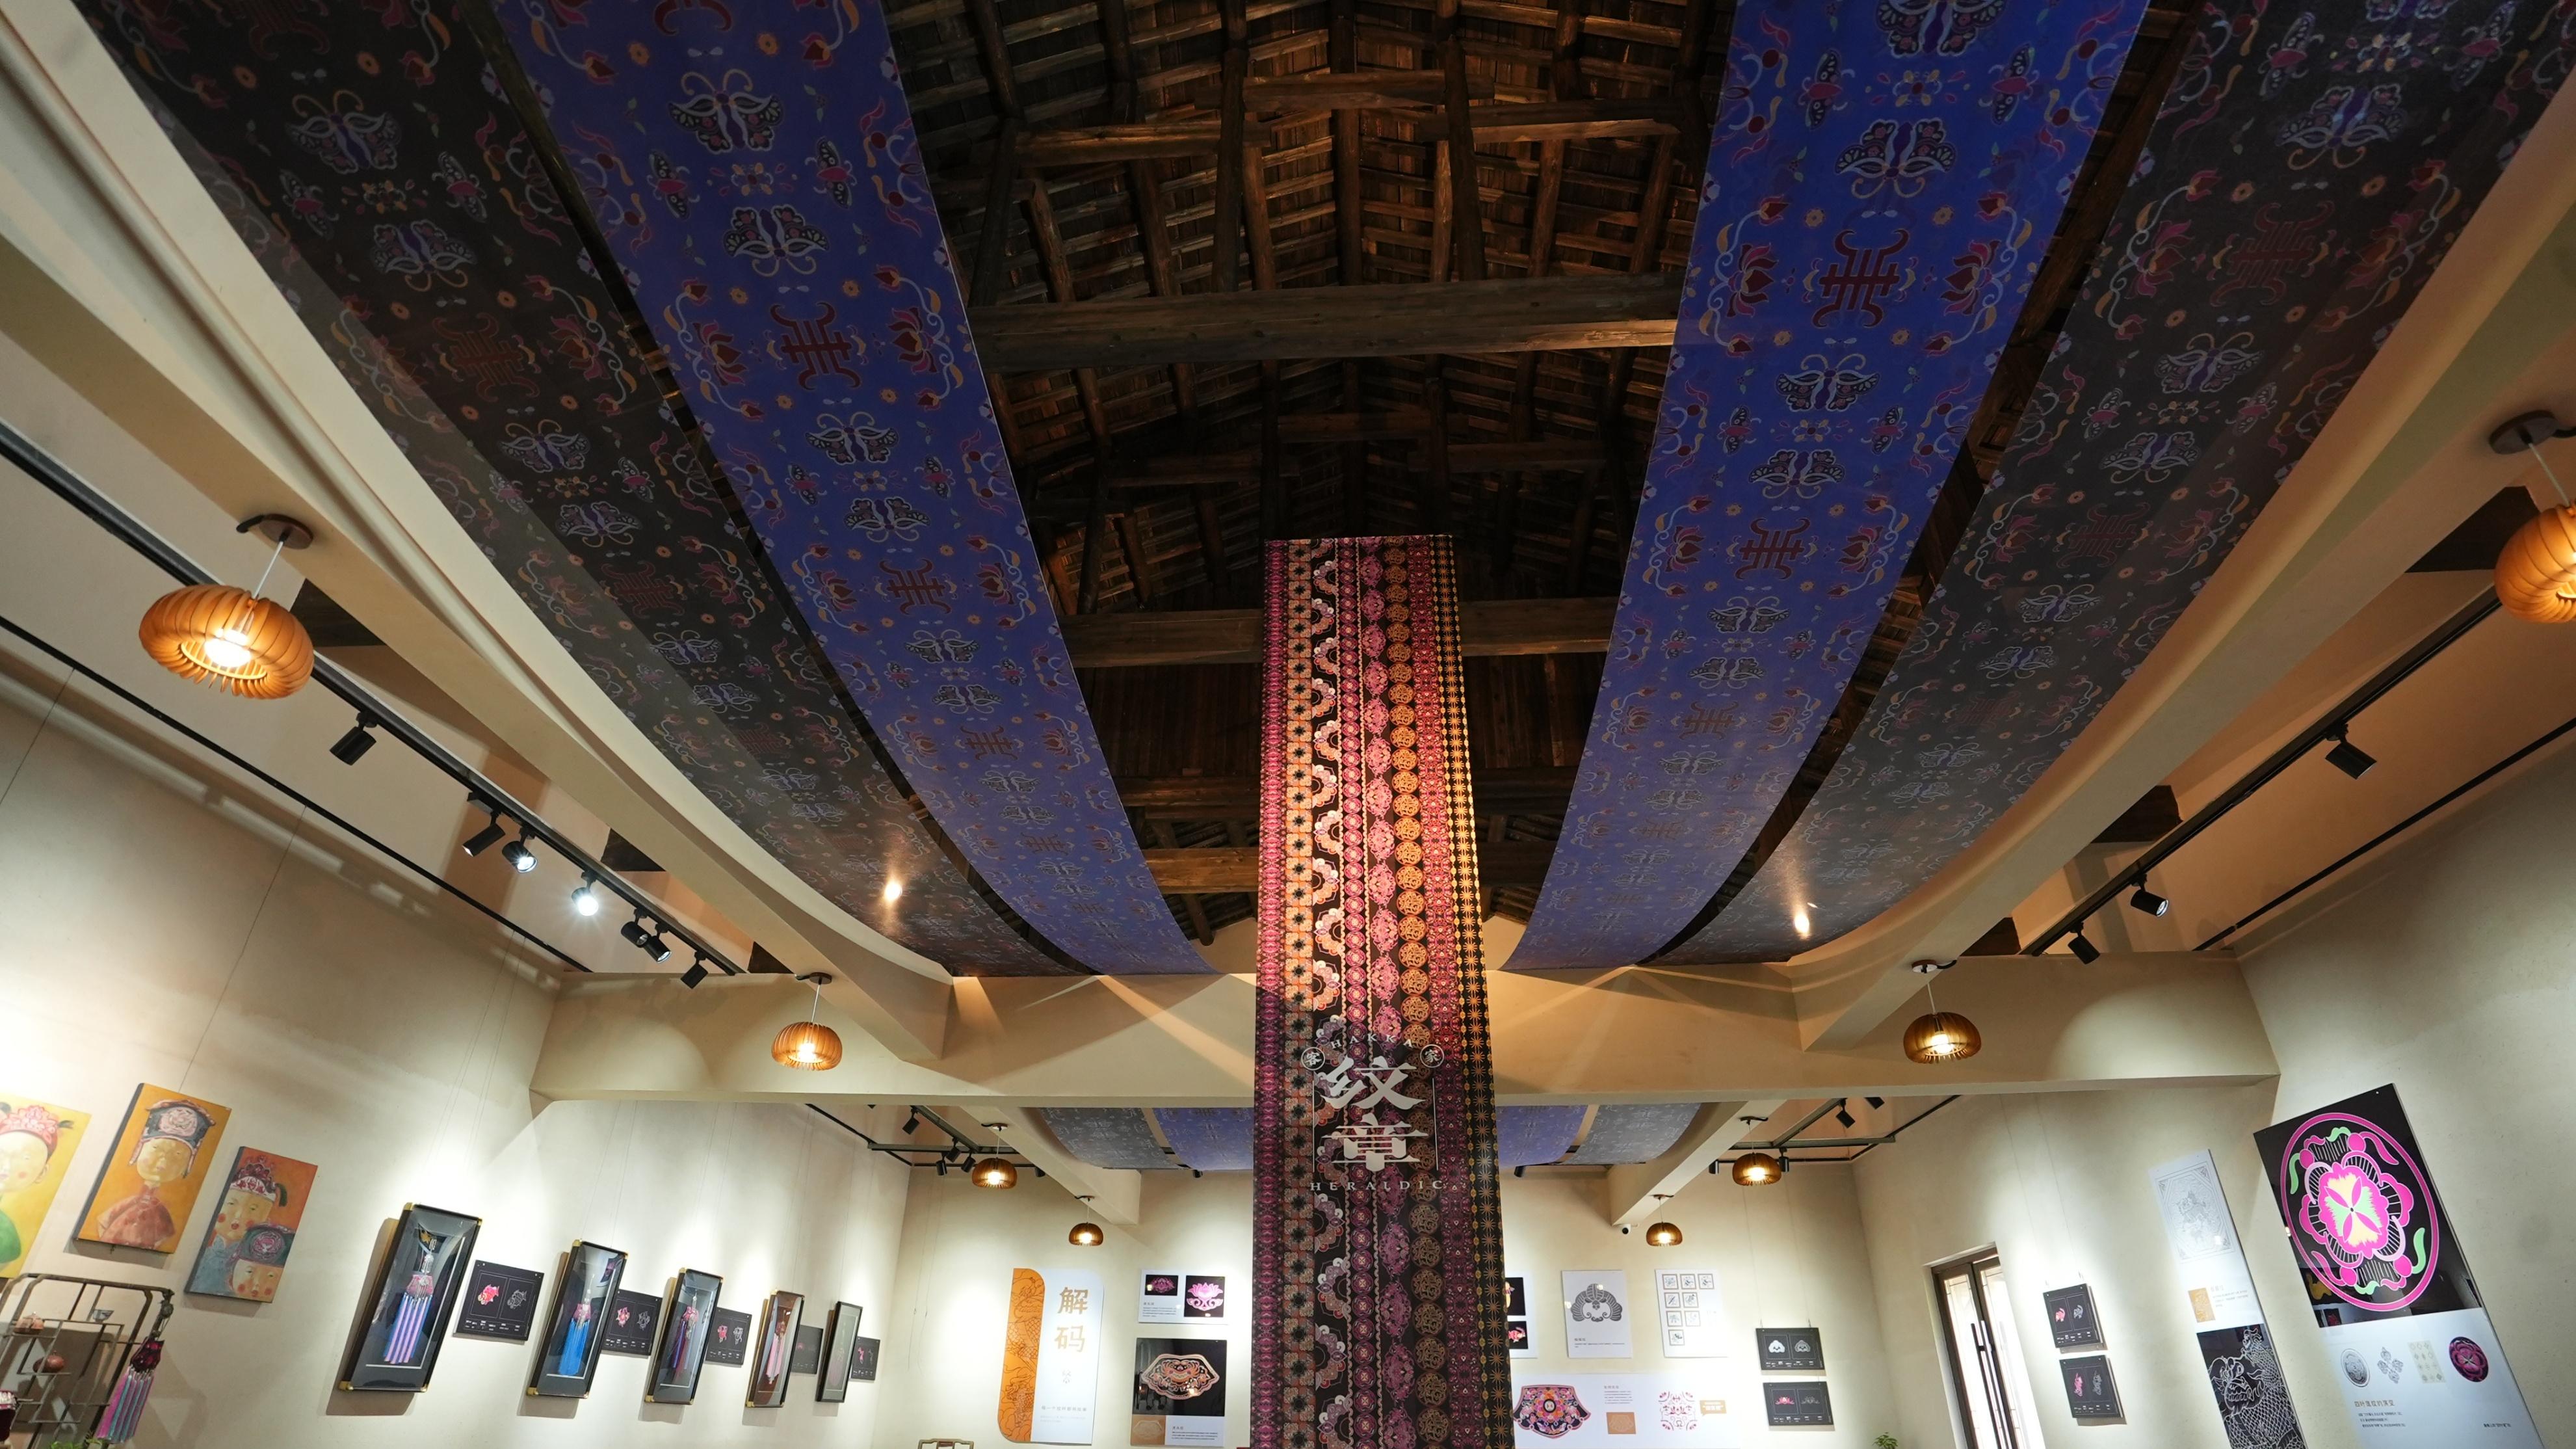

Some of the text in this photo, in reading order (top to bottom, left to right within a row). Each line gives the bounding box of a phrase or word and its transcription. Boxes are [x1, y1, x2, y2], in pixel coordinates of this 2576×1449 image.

[1331, 1033, 1413, 1050] HAKKA
[1305, 1049, 1440, 1066] 客 家
[1321, 1056, 1428, 1172] 纹章
[1310, 1180, 1443, 1191] HERALDIC
[1055, 1286, 1089, 1353] 解码
